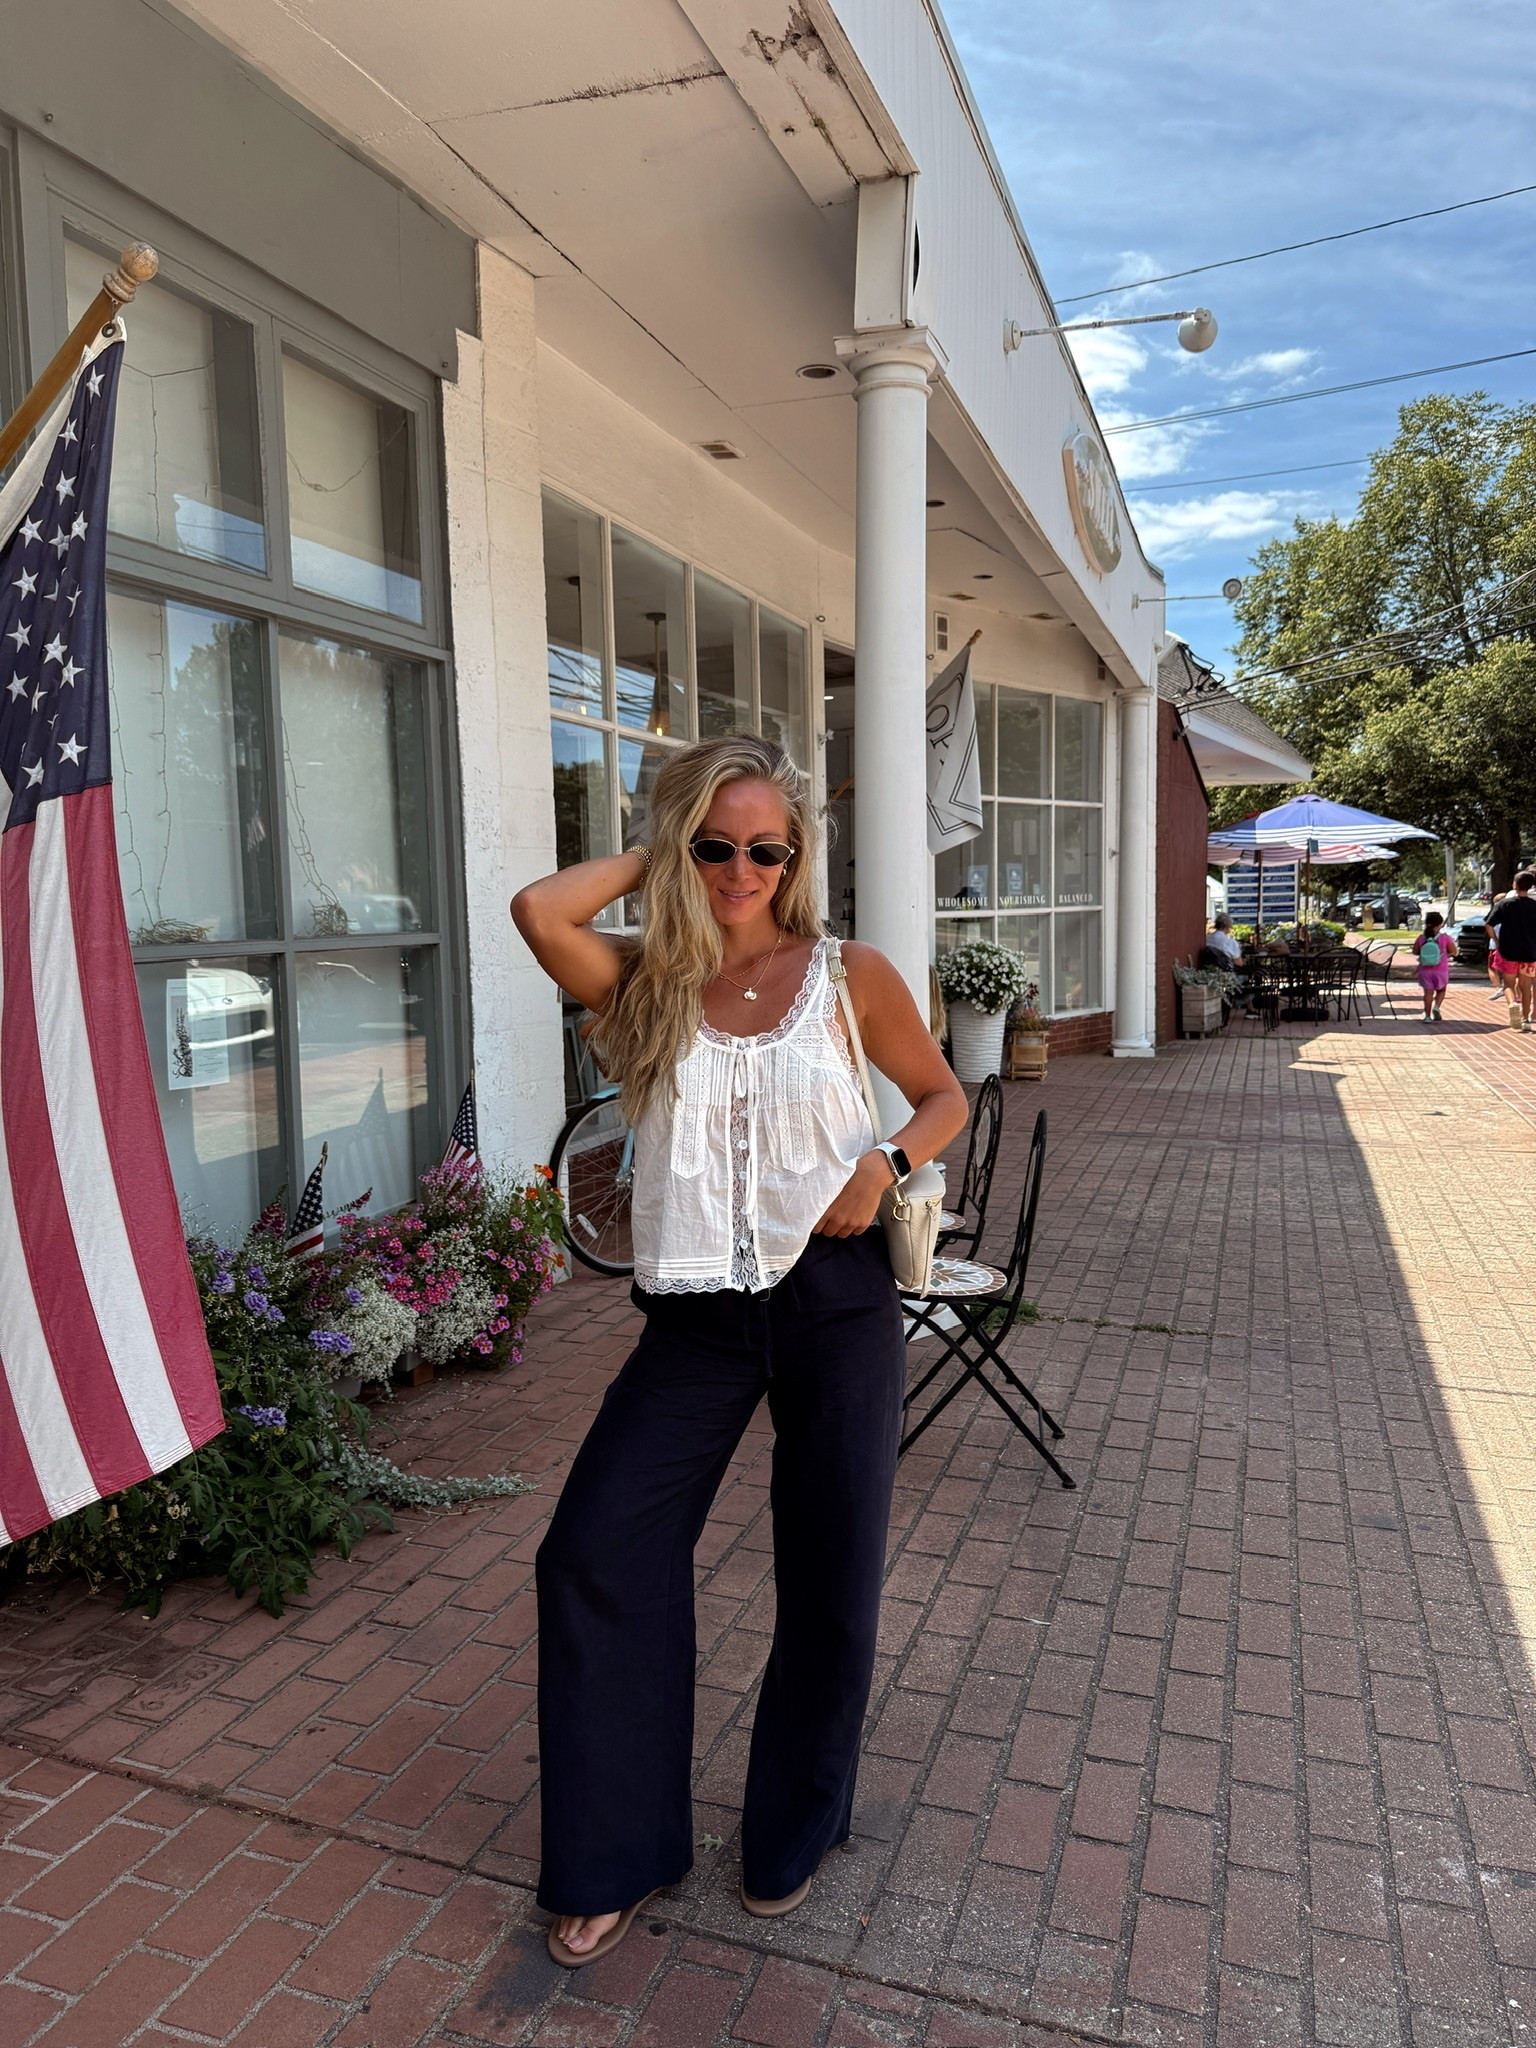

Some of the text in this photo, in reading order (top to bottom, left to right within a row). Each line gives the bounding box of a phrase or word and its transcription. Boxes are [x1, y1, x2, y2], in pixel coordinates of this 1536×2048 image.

[937, 893, 1093, 907] WHOLESOME NOURISHING BALANCED
